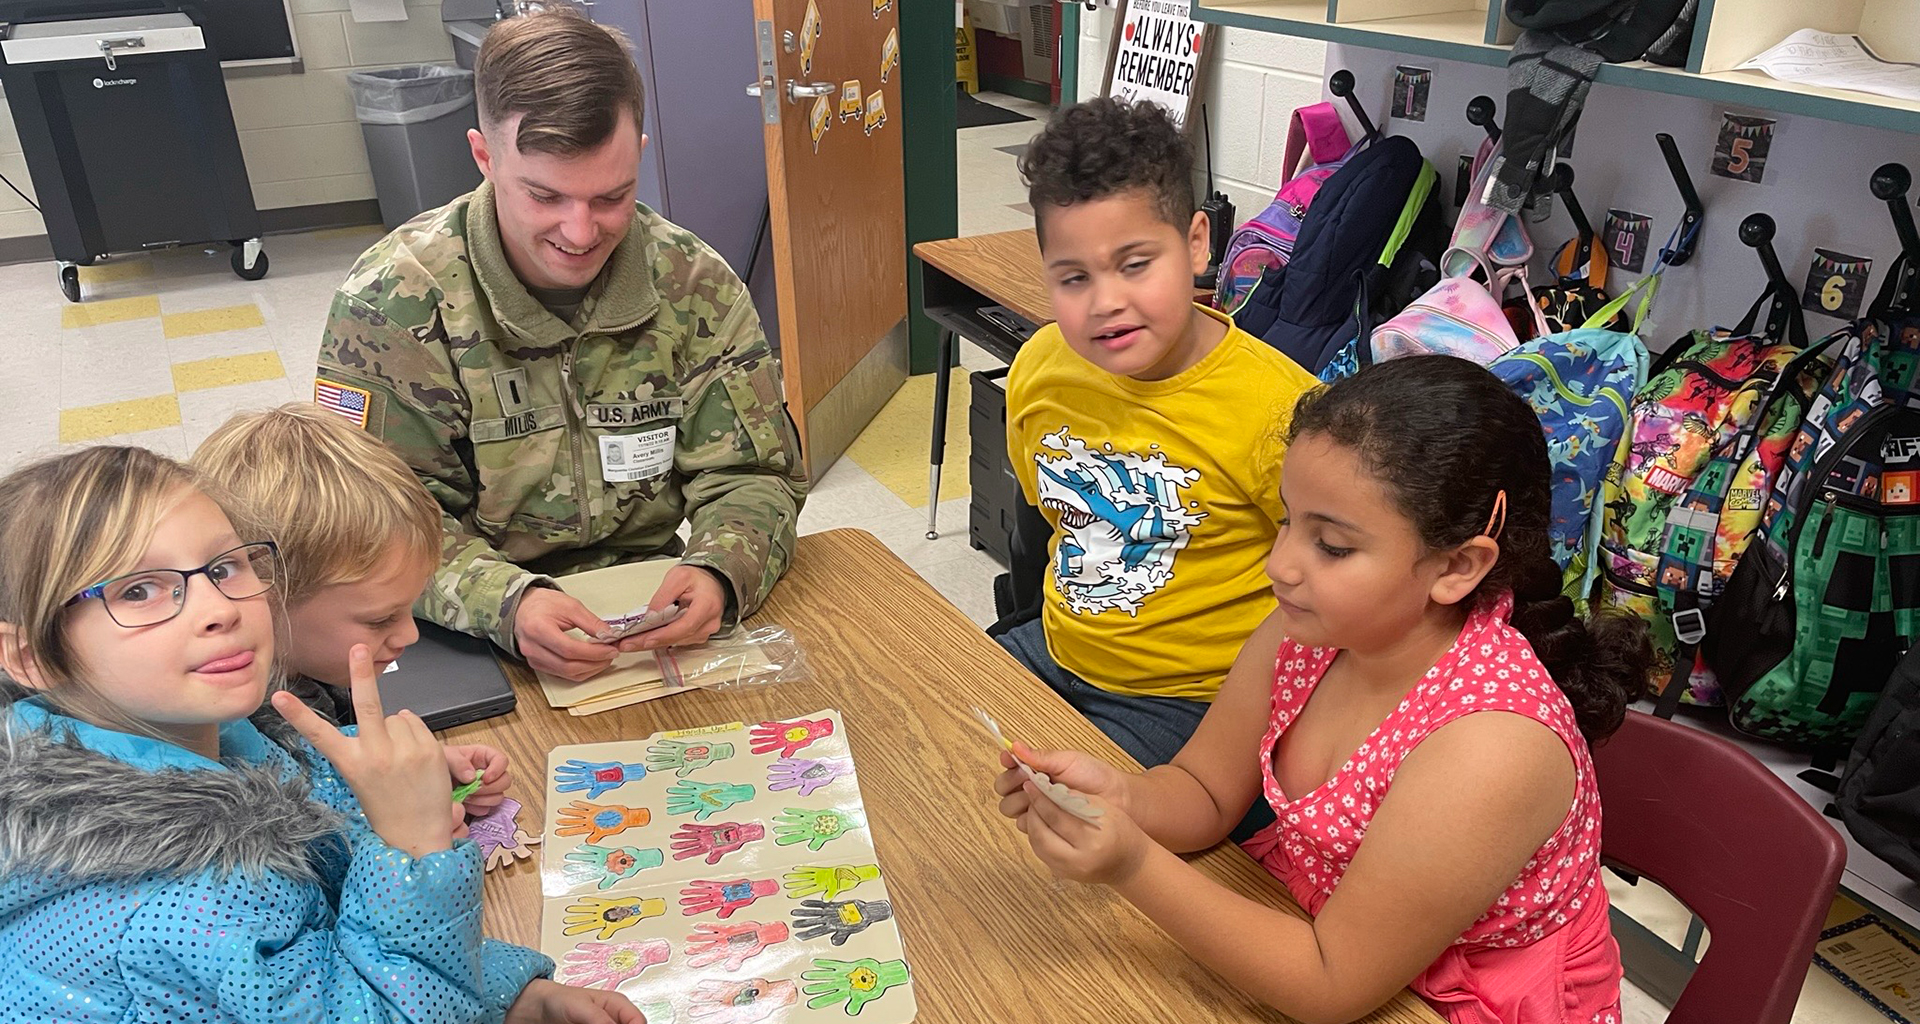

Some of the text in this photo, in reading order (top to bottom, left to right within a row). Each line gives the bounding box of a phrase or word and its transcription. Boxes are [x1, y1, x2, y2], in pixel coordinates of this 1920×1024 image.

[1133, 0, 1188, 17] BEFORE YOU LEAVE THIS
[1132, 15, 1195, 57] ALWAYS
[1118, 49, 1194, 96] REMEMBER
[1405, 84, 1414, 115] 1
[1727, 138, 1753, 174] 5
[1615, 231, 1634, 265] 4
[1821, 275, 1846, 311] 6
[598, 401, 672, 423] U.S. ARMY
[637, 431, 669, 443] VISITOR
[633, 451, 649, 459] Avery
